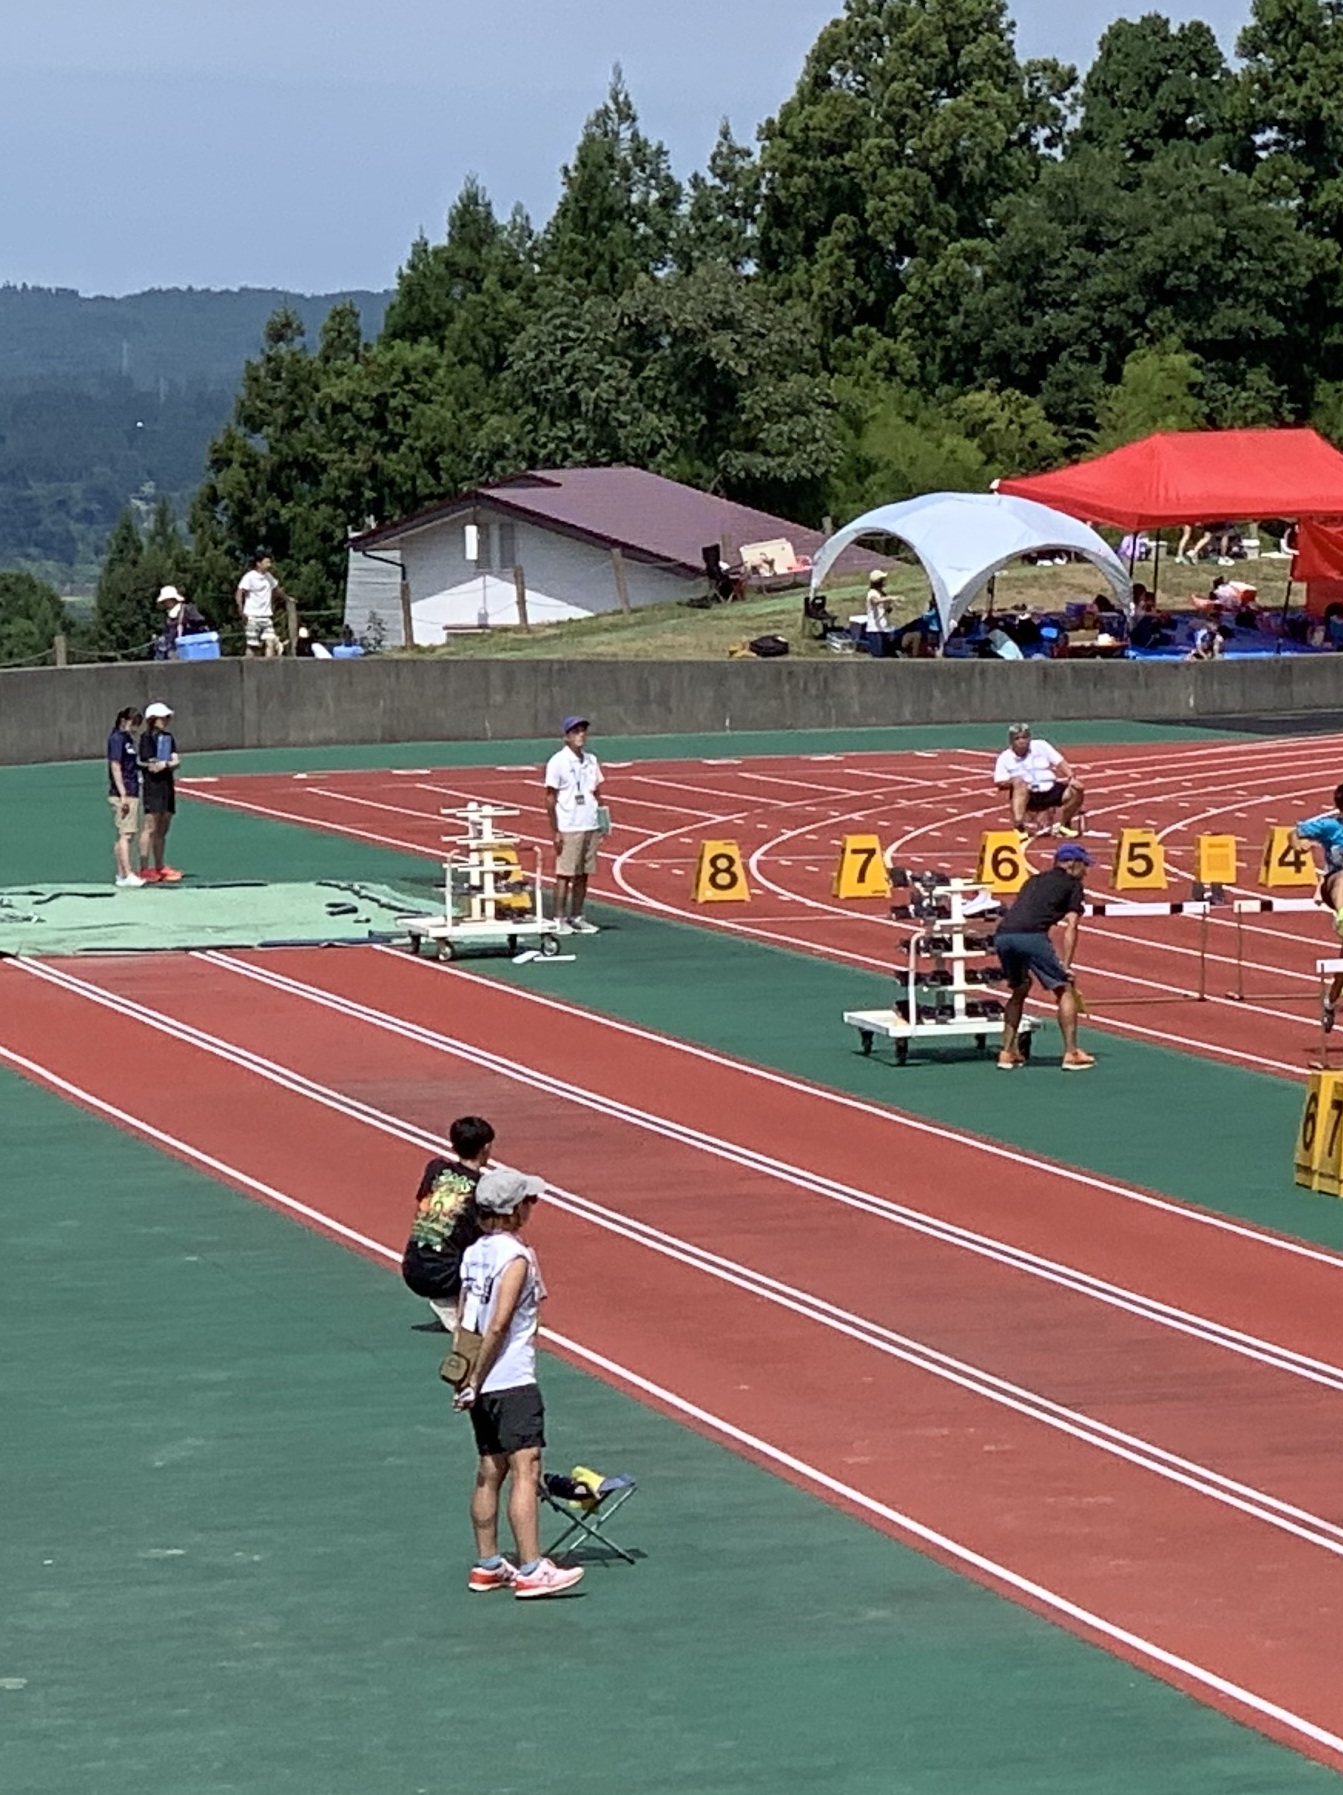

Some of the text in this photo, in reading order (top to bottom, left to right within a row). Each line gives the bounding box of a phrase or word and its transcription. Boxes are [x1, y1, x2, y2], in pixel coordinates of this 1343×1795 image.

[708, 852, 738, 891] 8
[850, 847, 876, 884] 7
[991, 844, 1020, 882] 6
[1126, 842, 1154, 878] 5
[1278, 841, 1306, 874] 4
[1302, 1091, 1318, 1151] 6
[1328, 1099, 1343, 1158] 7
